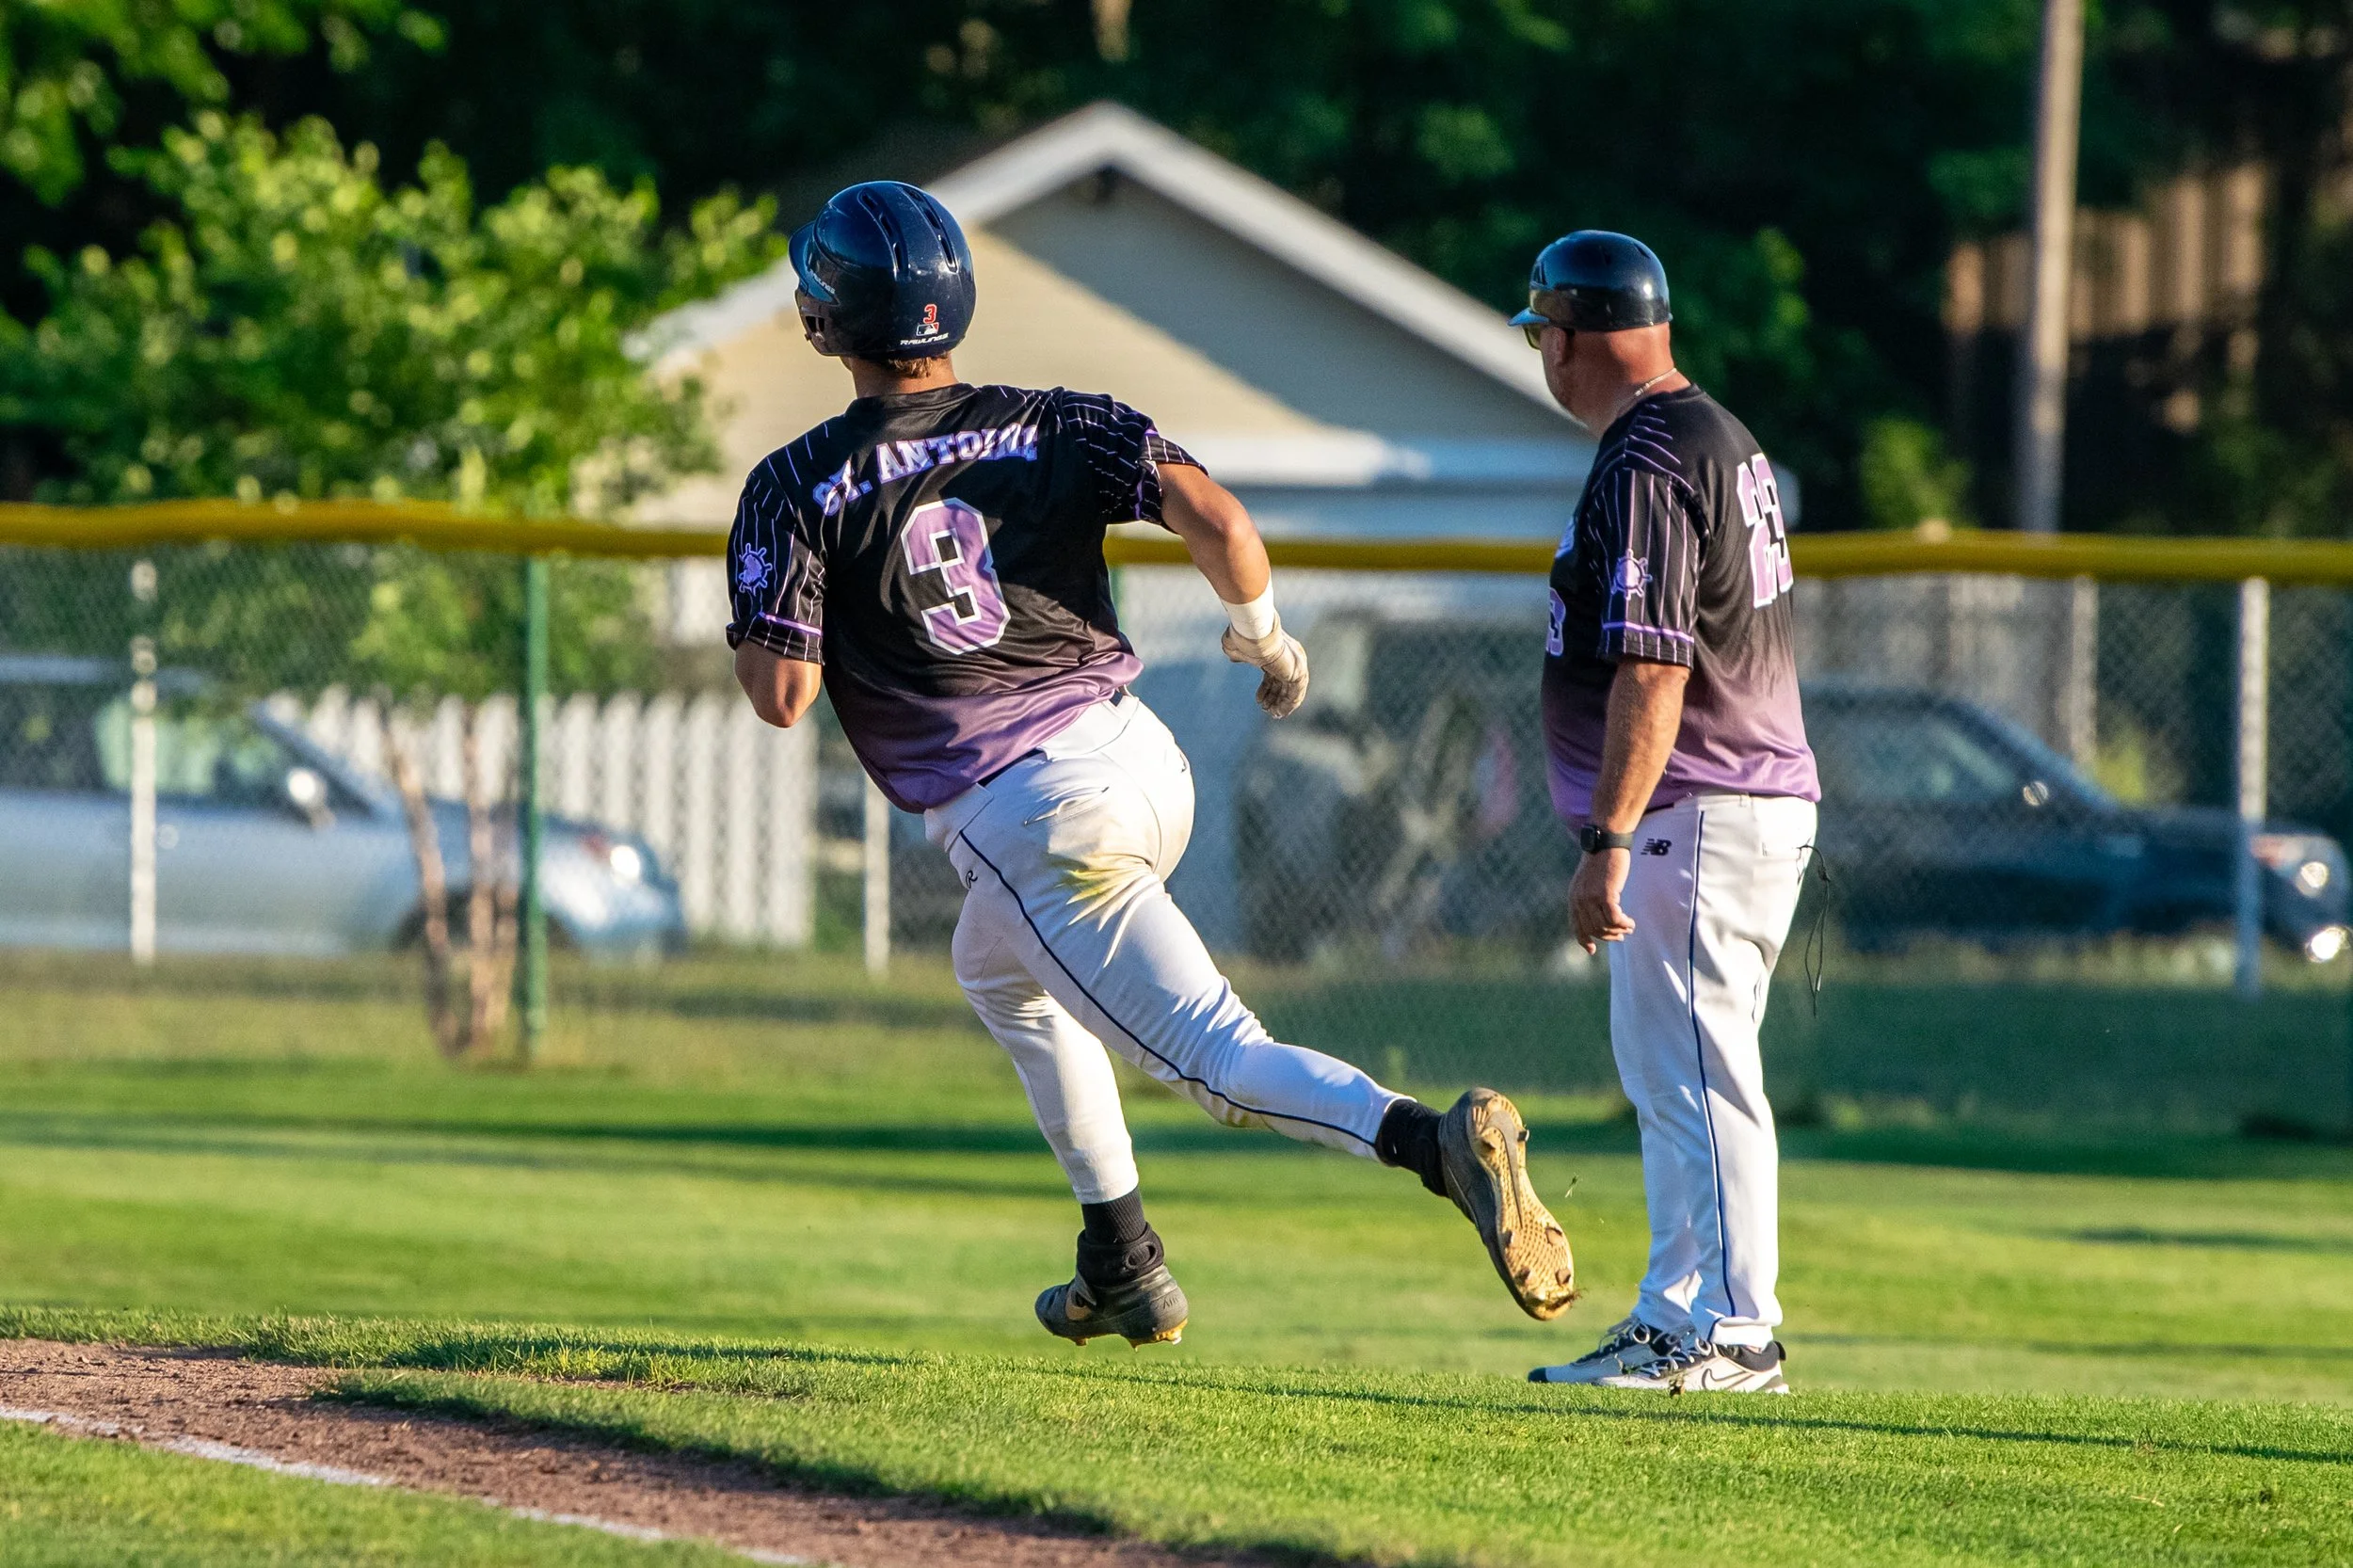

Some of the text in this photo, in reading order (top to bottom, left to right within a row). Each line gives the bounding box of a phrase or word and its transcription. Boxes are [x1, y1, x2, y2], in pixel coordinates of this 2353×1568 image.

[900, 332, 950, 345] RAWLINGS
[923, 304, 937, 324] 3
[813, 459, 872, 516] ST.
[1737, 452, 1794, 609] 23
[901, 497, 1011, 655] 3
